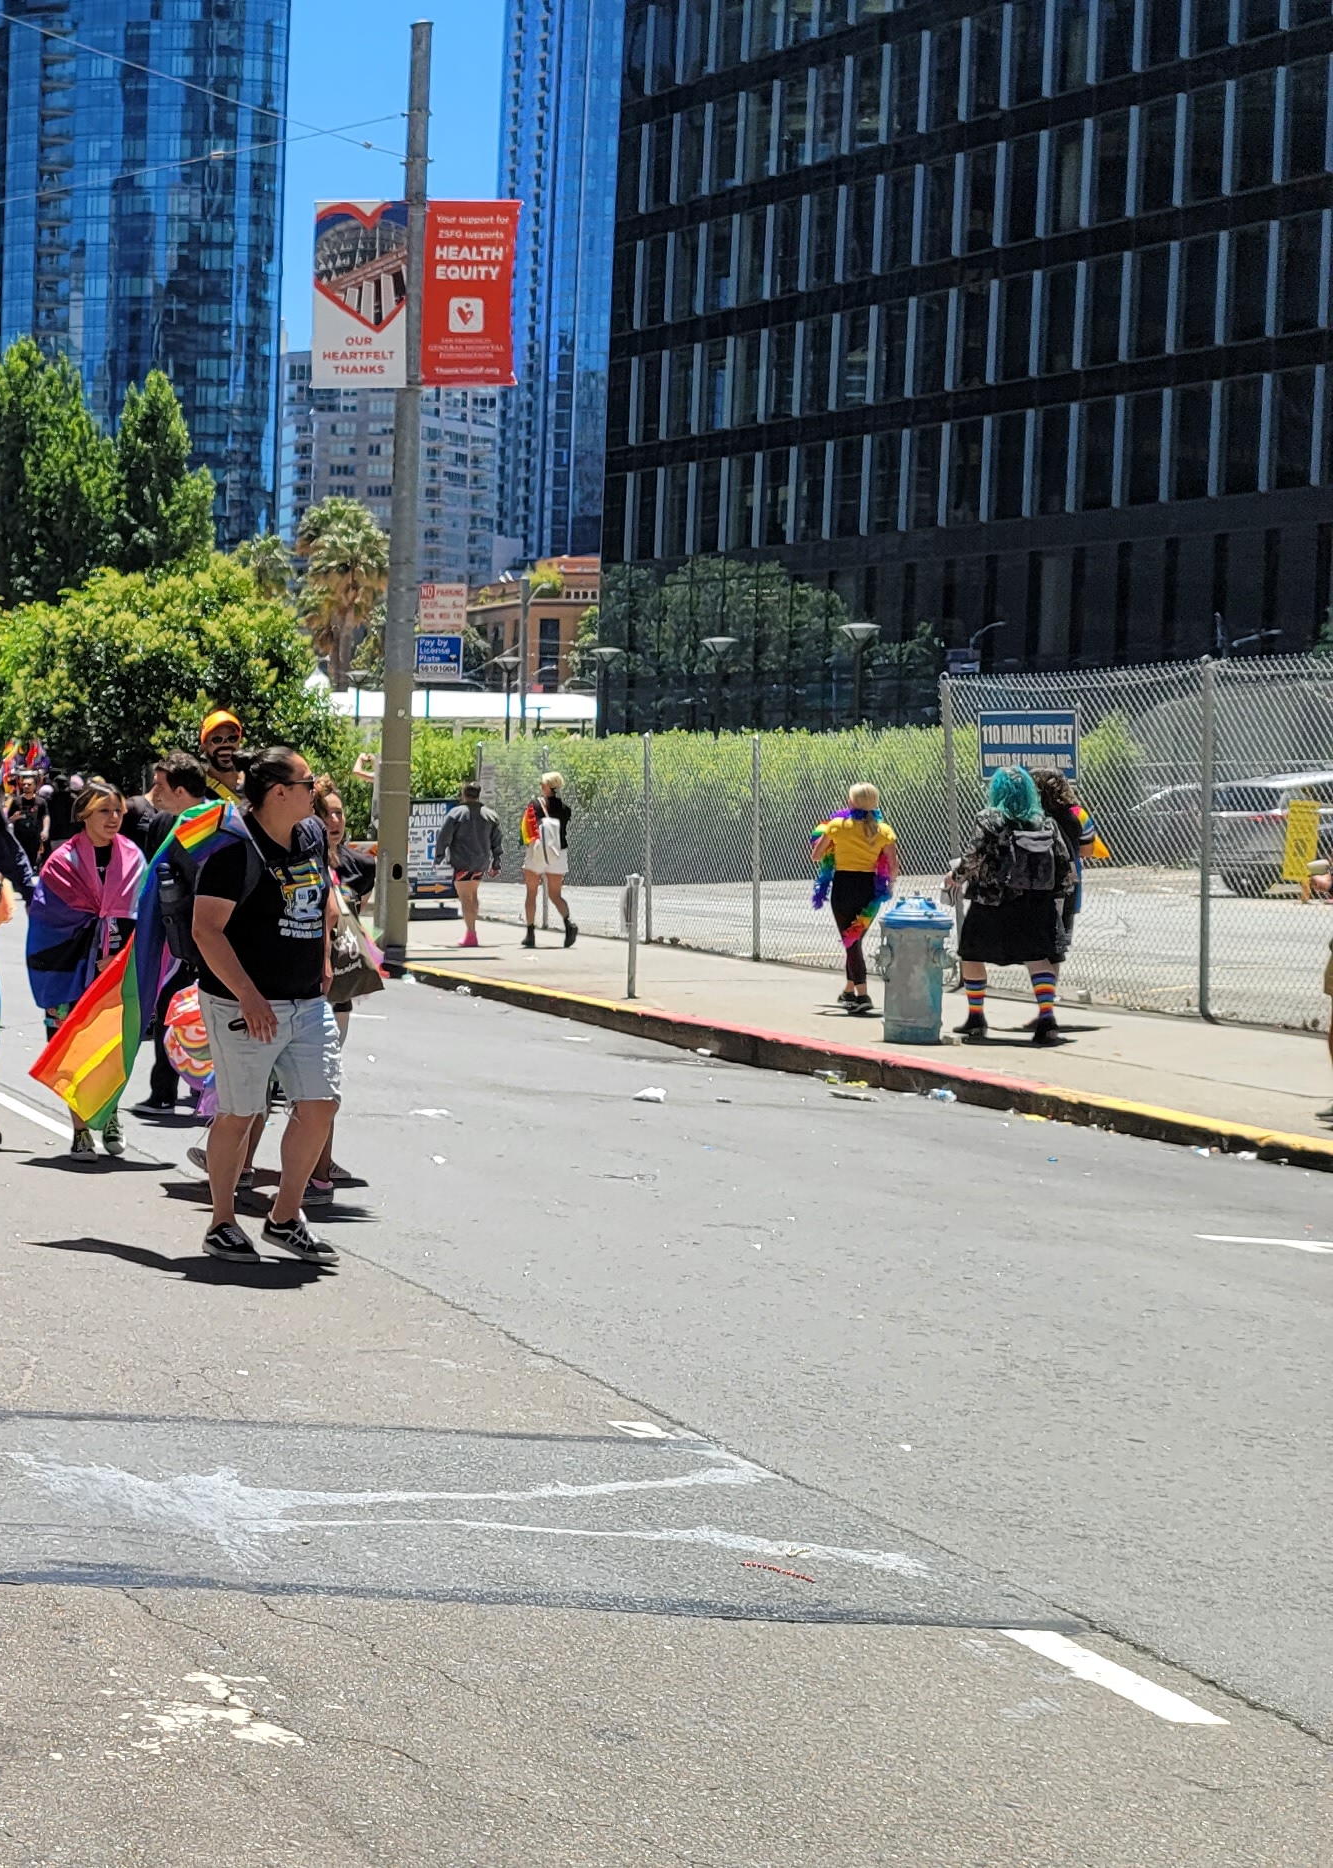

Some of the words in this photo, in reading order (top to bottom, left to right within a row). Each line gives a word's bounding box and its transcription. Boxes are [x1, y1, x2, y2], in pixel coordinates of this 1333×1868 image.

[436, 214, 456, 223] Your
[459, 215, 494, 224] support
[496, 214, 509, 223] for
[435, 245, 503, 260] HEALTH
[435, 264, 500, 280] EQUITY
[345, 336, 373, 346] OUR
[322, 351, 395, 360] HEARTFELT
[333, 365, 385, 374] THANKS
[421, 585, 434, 598] NO
[436, 589, 464, 597] PARKING
[419, 638, 435, 648] Pay
[437, 638, 448, 648] by
[419, 647, 450, 655] License
[982, 725, 1000, 744] 110
[1001, 725, 1031, 744] MAIN
[1033, 724, 1073, 744] STREET
[984, 753, 1011, 767] UNITED
[1022, 753, 1056, 768] PARKING
[413, 803, 447, 815] PUBLIC
[408, 816, 446, 827] PARKIN
